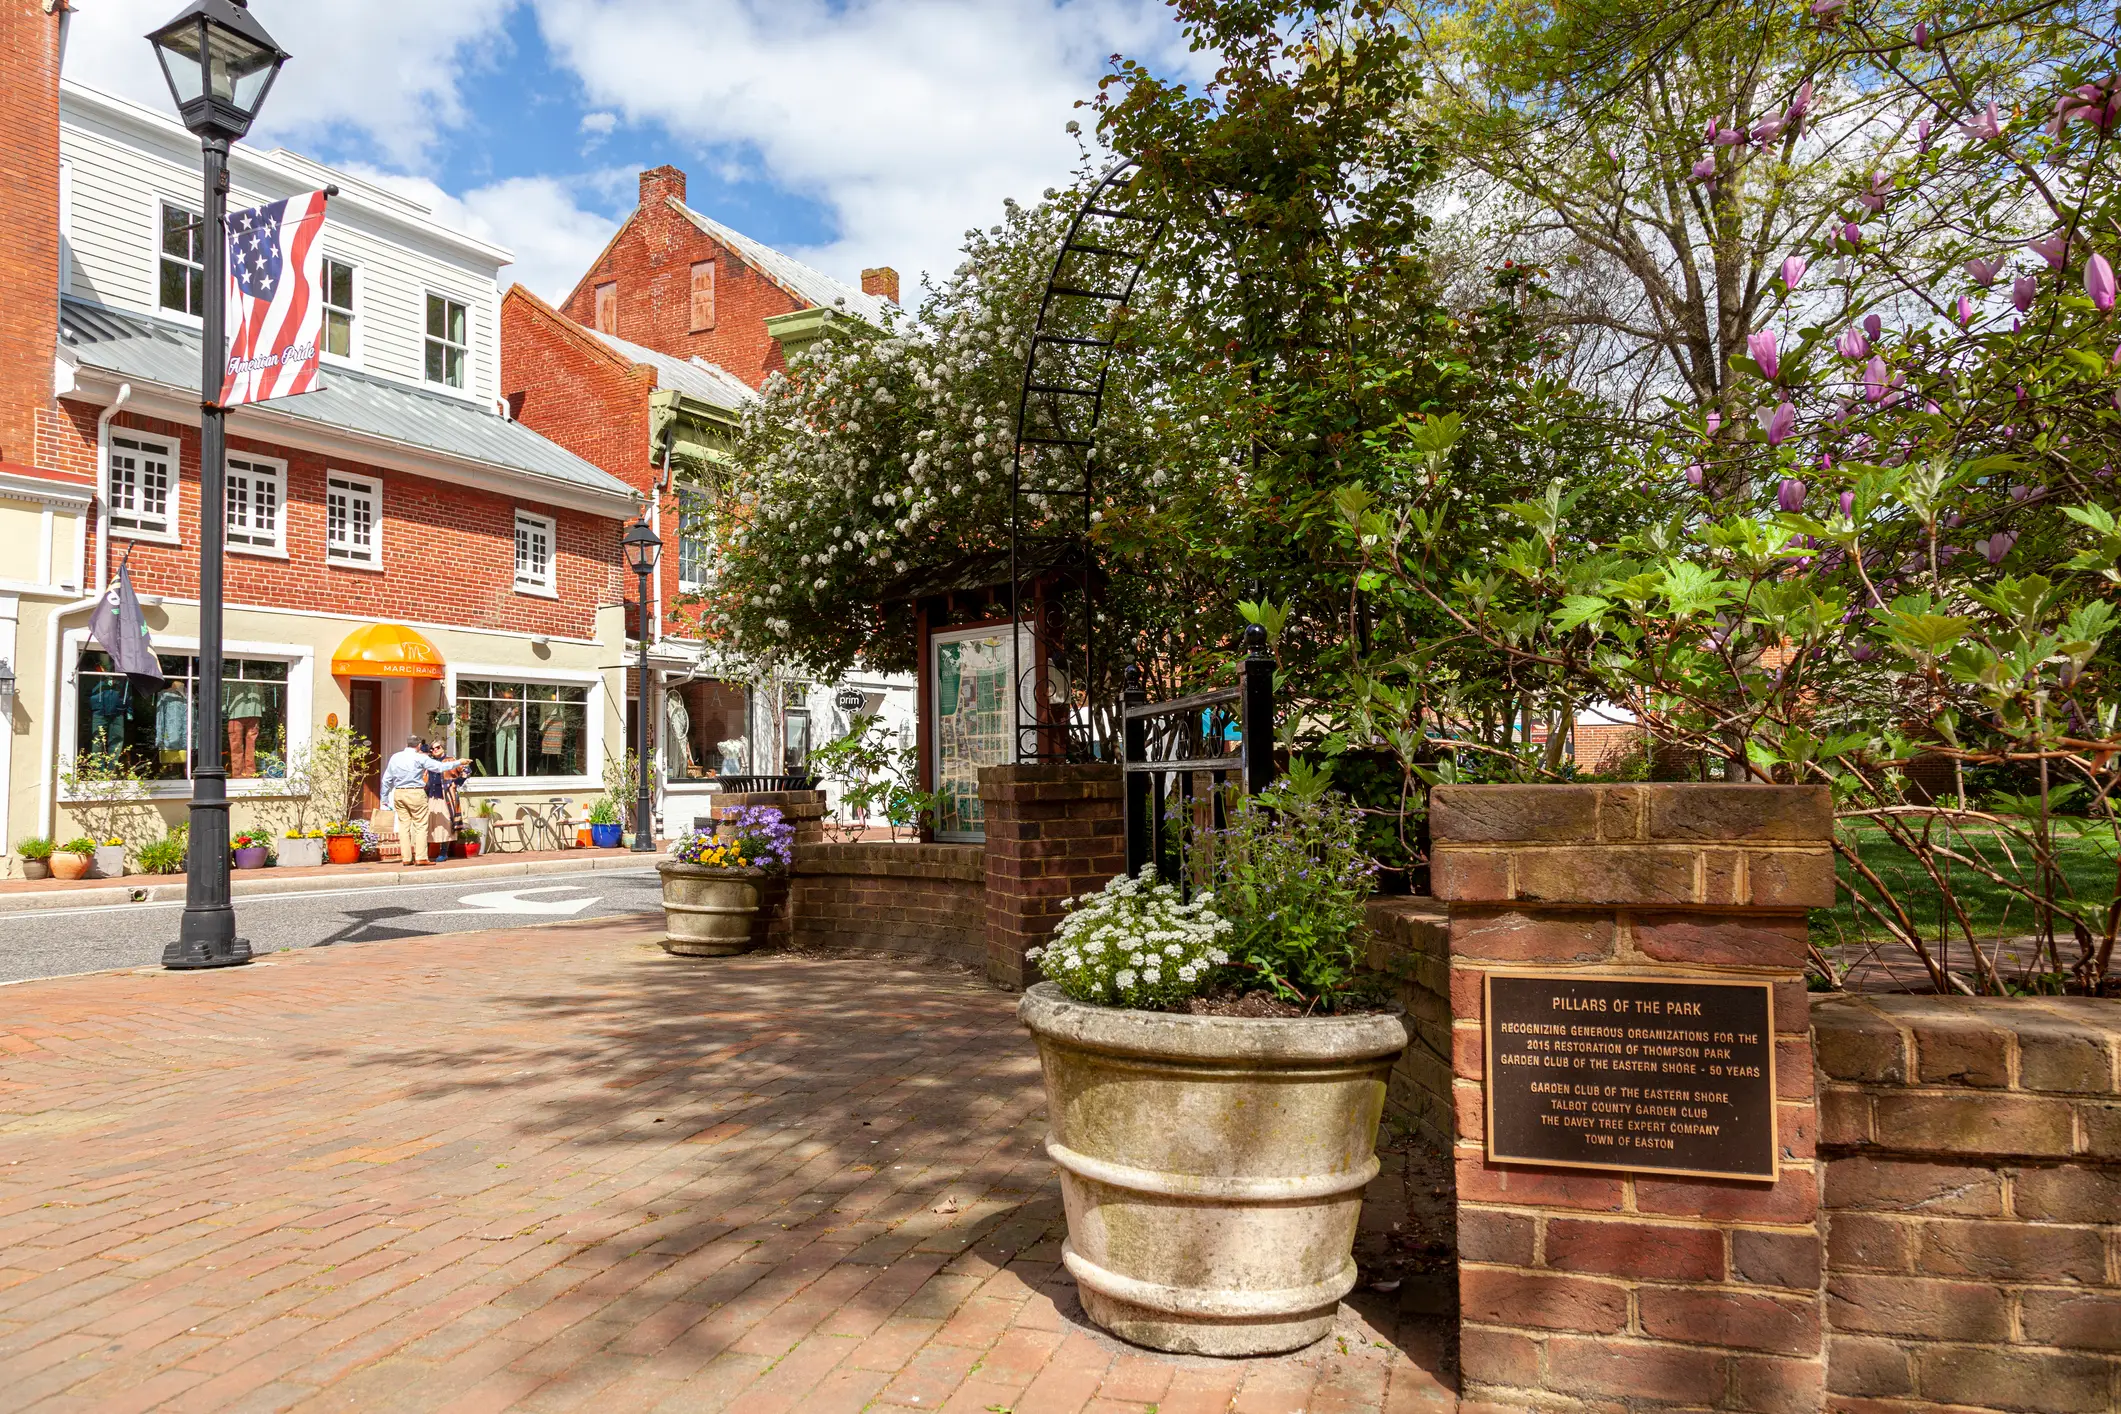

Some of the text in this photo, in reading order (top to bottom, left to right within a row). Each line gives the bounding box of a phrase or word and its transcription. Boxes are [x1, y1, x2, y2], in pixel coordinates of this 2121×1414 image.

[228, 341, 315, 375] American Pride
[383, 665, 411, 673] MARC
[839, 695, 860, 706] prim
[1552, 997, 1702, 1016] PILLARS OF THE PARK
[1501, 1022, 1758, 1045] RECOGNIZING GENEROUS ORGANIZATIONS FOR THE
[1526, 1039, 1731, 1060] 2015 RESTORATION OF THOMPSON PARK
[1500, 1054, 1540, 1066] GARDEN
[1543, 1055, 1569, 1068] CLUB
[1573, 1057, 1586, 1069] OF
[1589, 1058, 1608, 1070] THE
[1612, 1060, 1658, 1072] EASTERN
[1662, 1062, 1697, 1075] SHORE
[1709, 1065, 1722, 1076] 50
[1726, 1065, 1761, 1078] YEARS
[1530, 1081, 1729, 1104] GARDEN CLUB OF THE EASTERN SHORE
[1551, 1099, 1708, 1119] TALBOT COUNTY GARDEN CLUB
[1541, 1114, 1720, 1136] THE DAVEY TREE EXPERT COMPANY
[1584, 1133, 1674, 1150] TOWN OF EASTON
